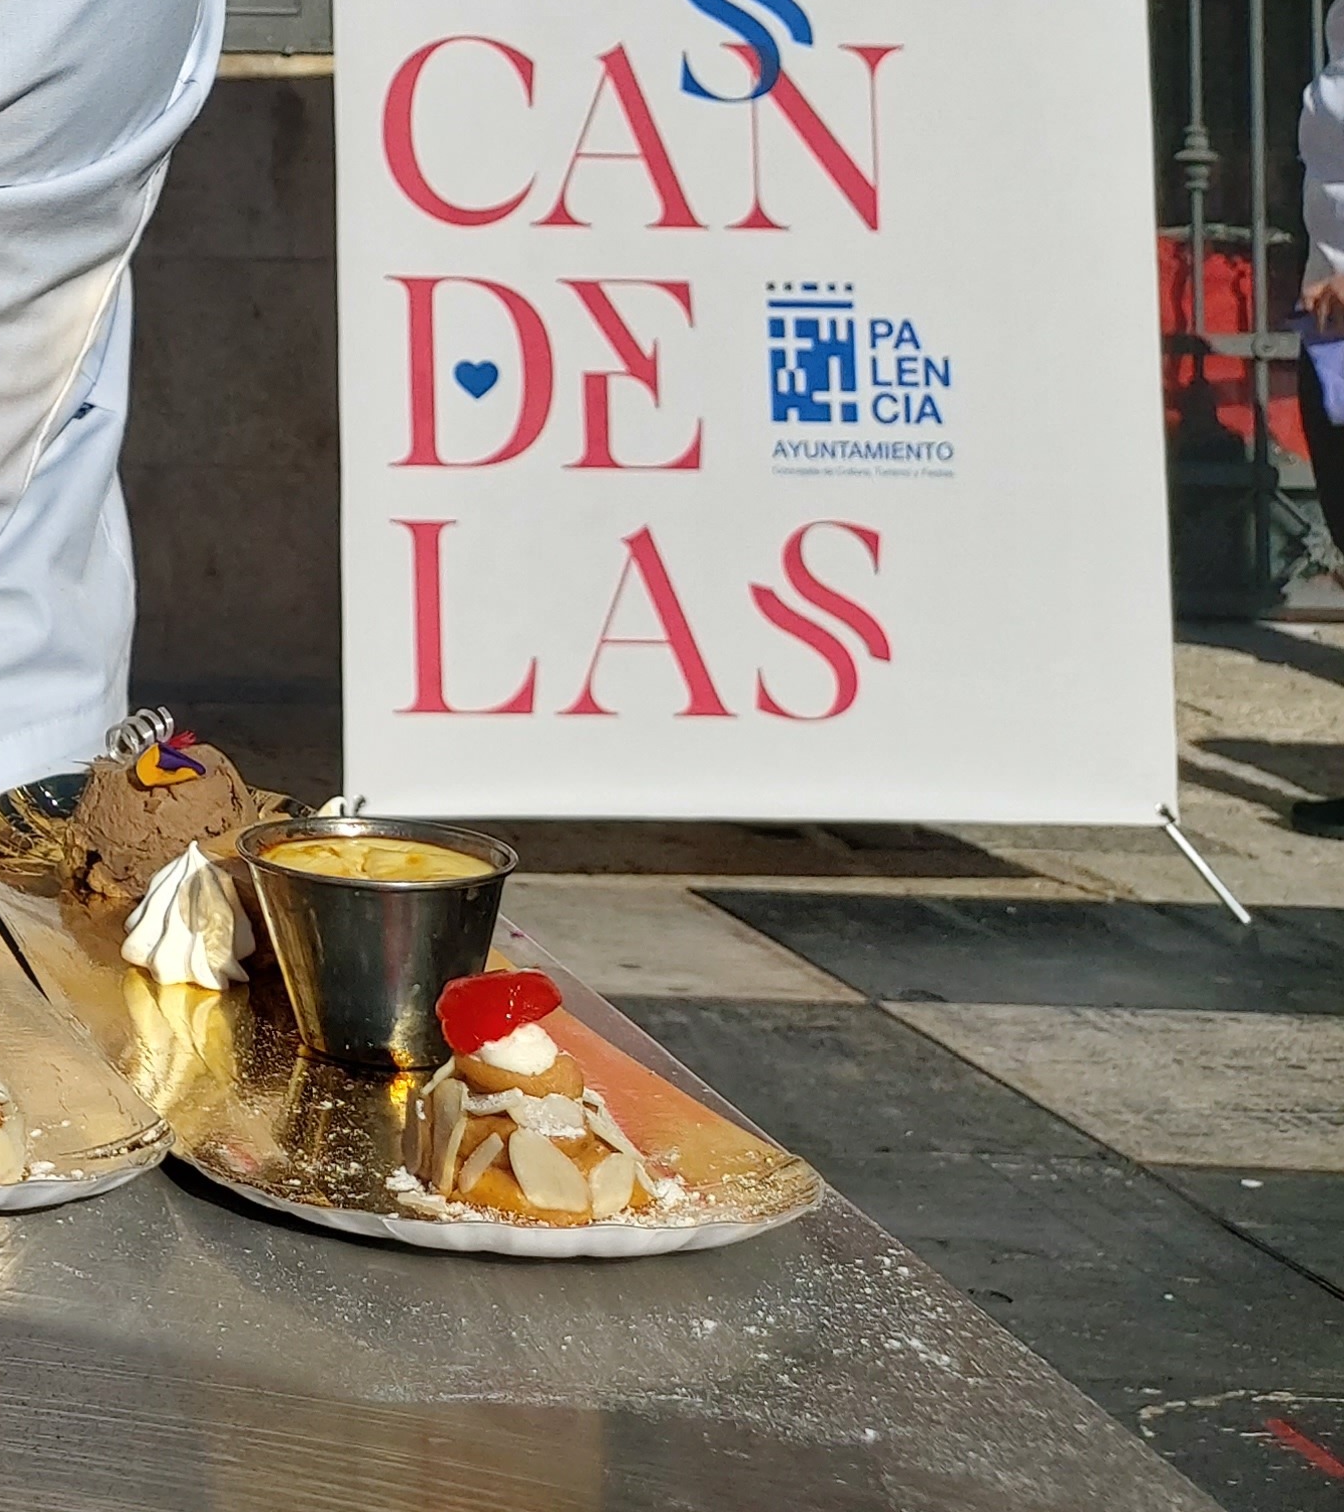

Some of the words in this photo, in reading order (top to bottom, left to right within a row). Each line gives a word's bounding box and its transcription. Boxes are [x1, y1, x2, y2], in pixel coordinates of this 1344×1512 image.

[382, 35, 903, 231] CAN
[870, 319, 920, 350] PA
[385, 275, 703, 470] DE
[871, 355, 952, 387] LEN
[872, 393, 944, 424] CIA
[771, 439, 954, 462] AYUNTAMIENTO
[390, 519, 890, 721] LAS
